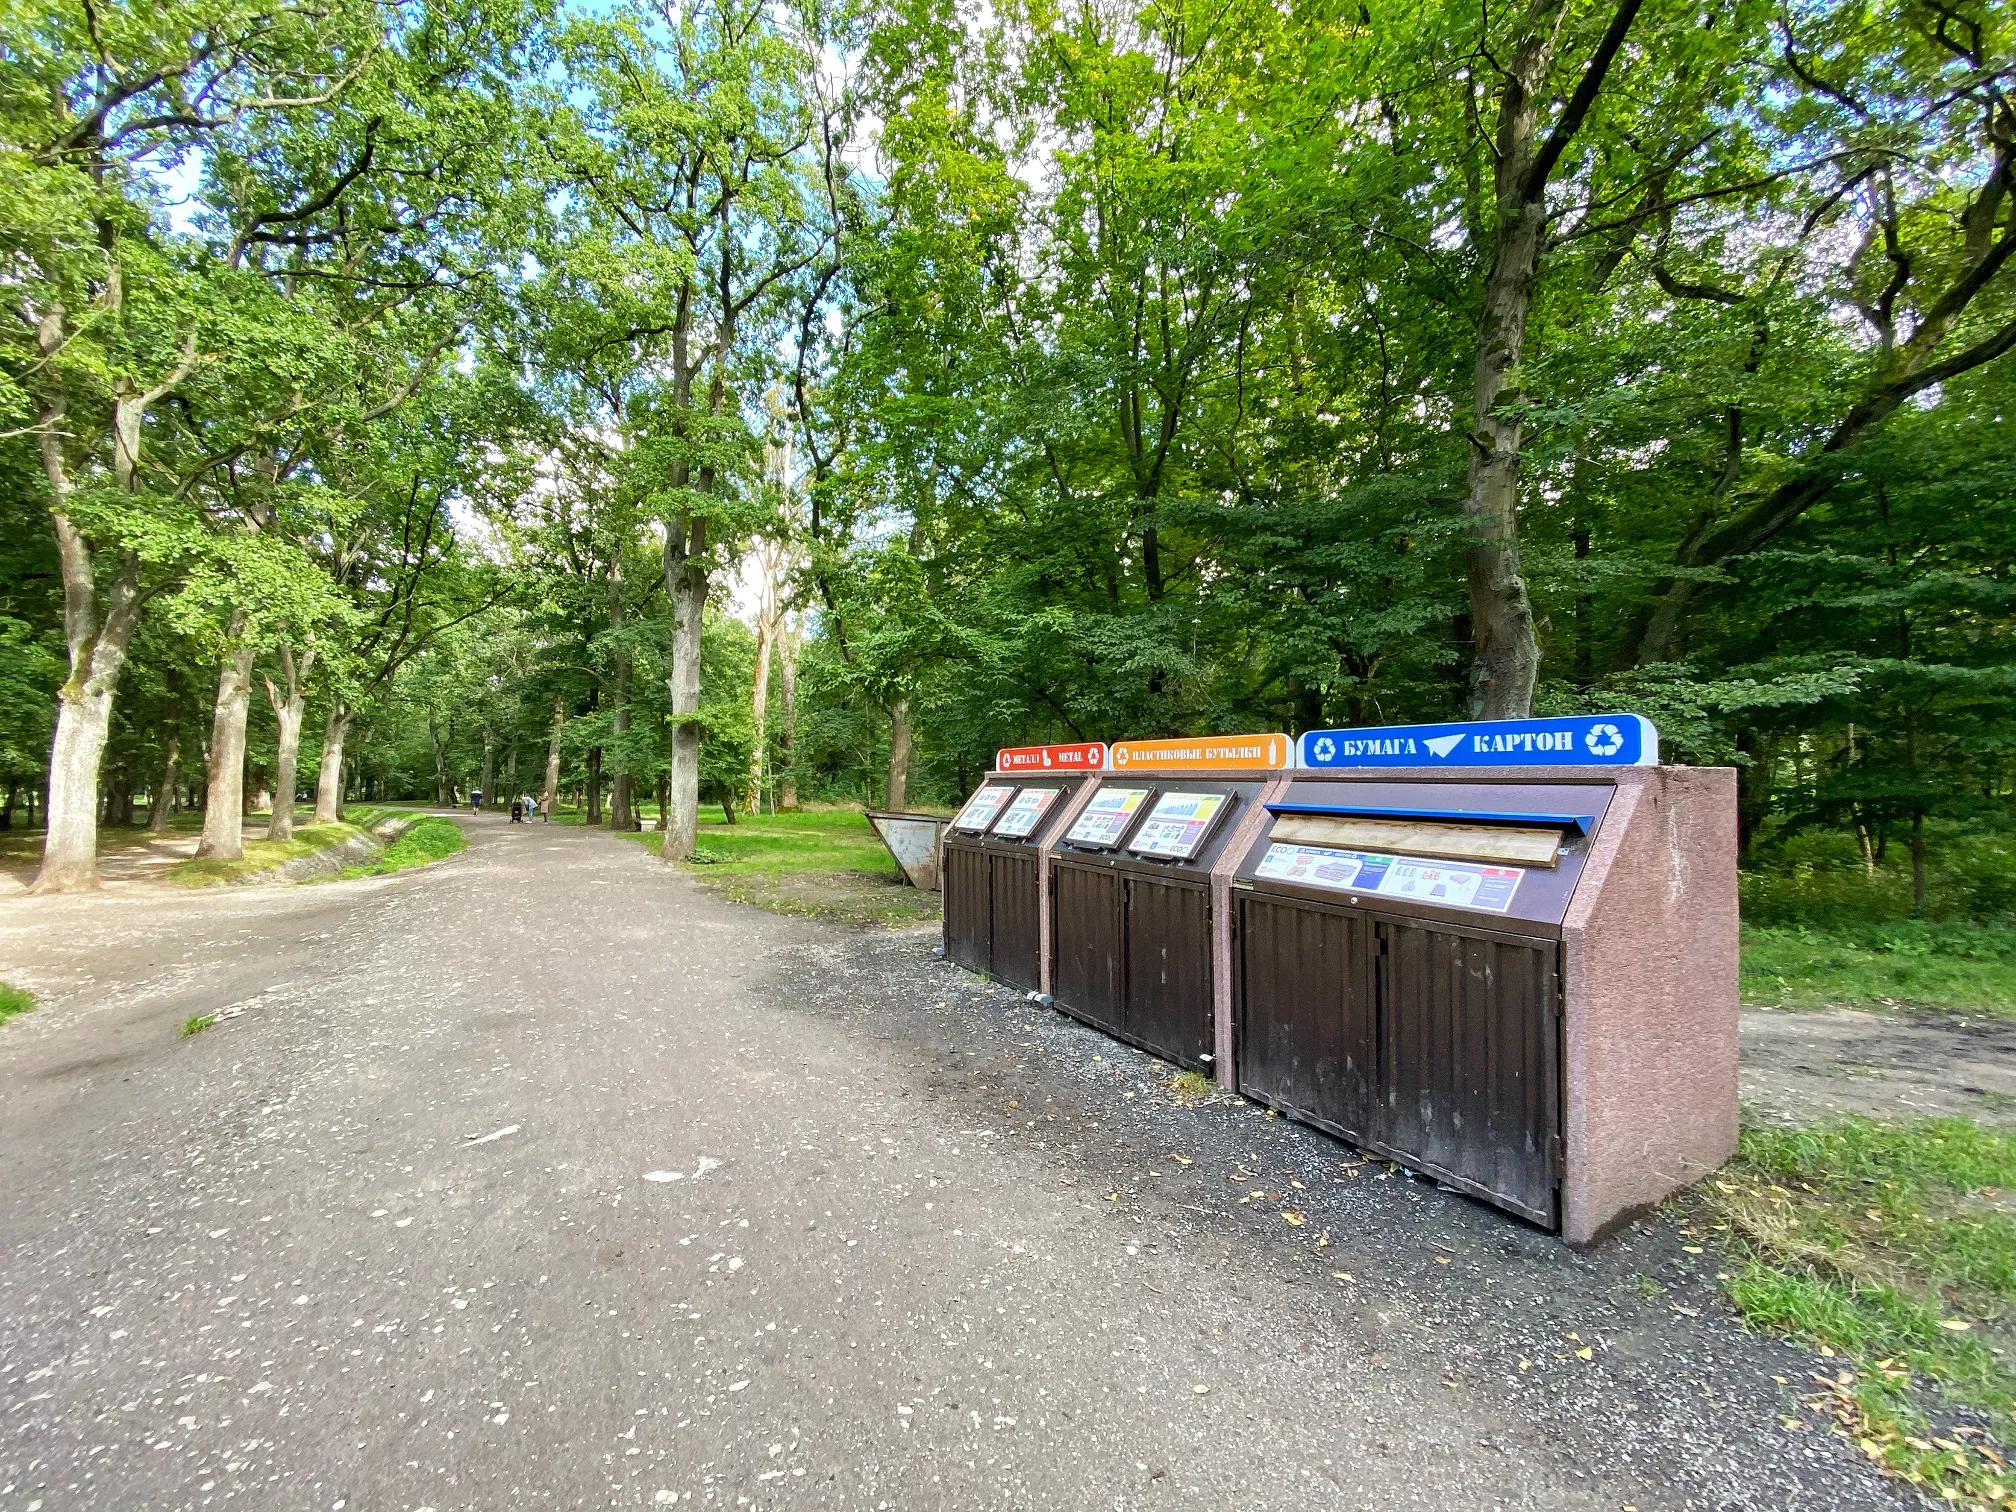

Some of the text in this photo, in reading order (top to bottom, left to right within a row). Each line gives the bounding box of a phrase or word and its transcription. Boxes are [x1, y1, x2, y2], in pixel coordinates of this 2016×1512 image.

[1343, 731, 1573, 757] БУМАГА КАРТОН
[1013, 754, 1040, 765] МЕТАЛЛ
[1058, 751, 1083, 763] METAL
[1132, 746, 1261, 761] ПЛАСТИКОВЫЕ БУТЫЛКИ
